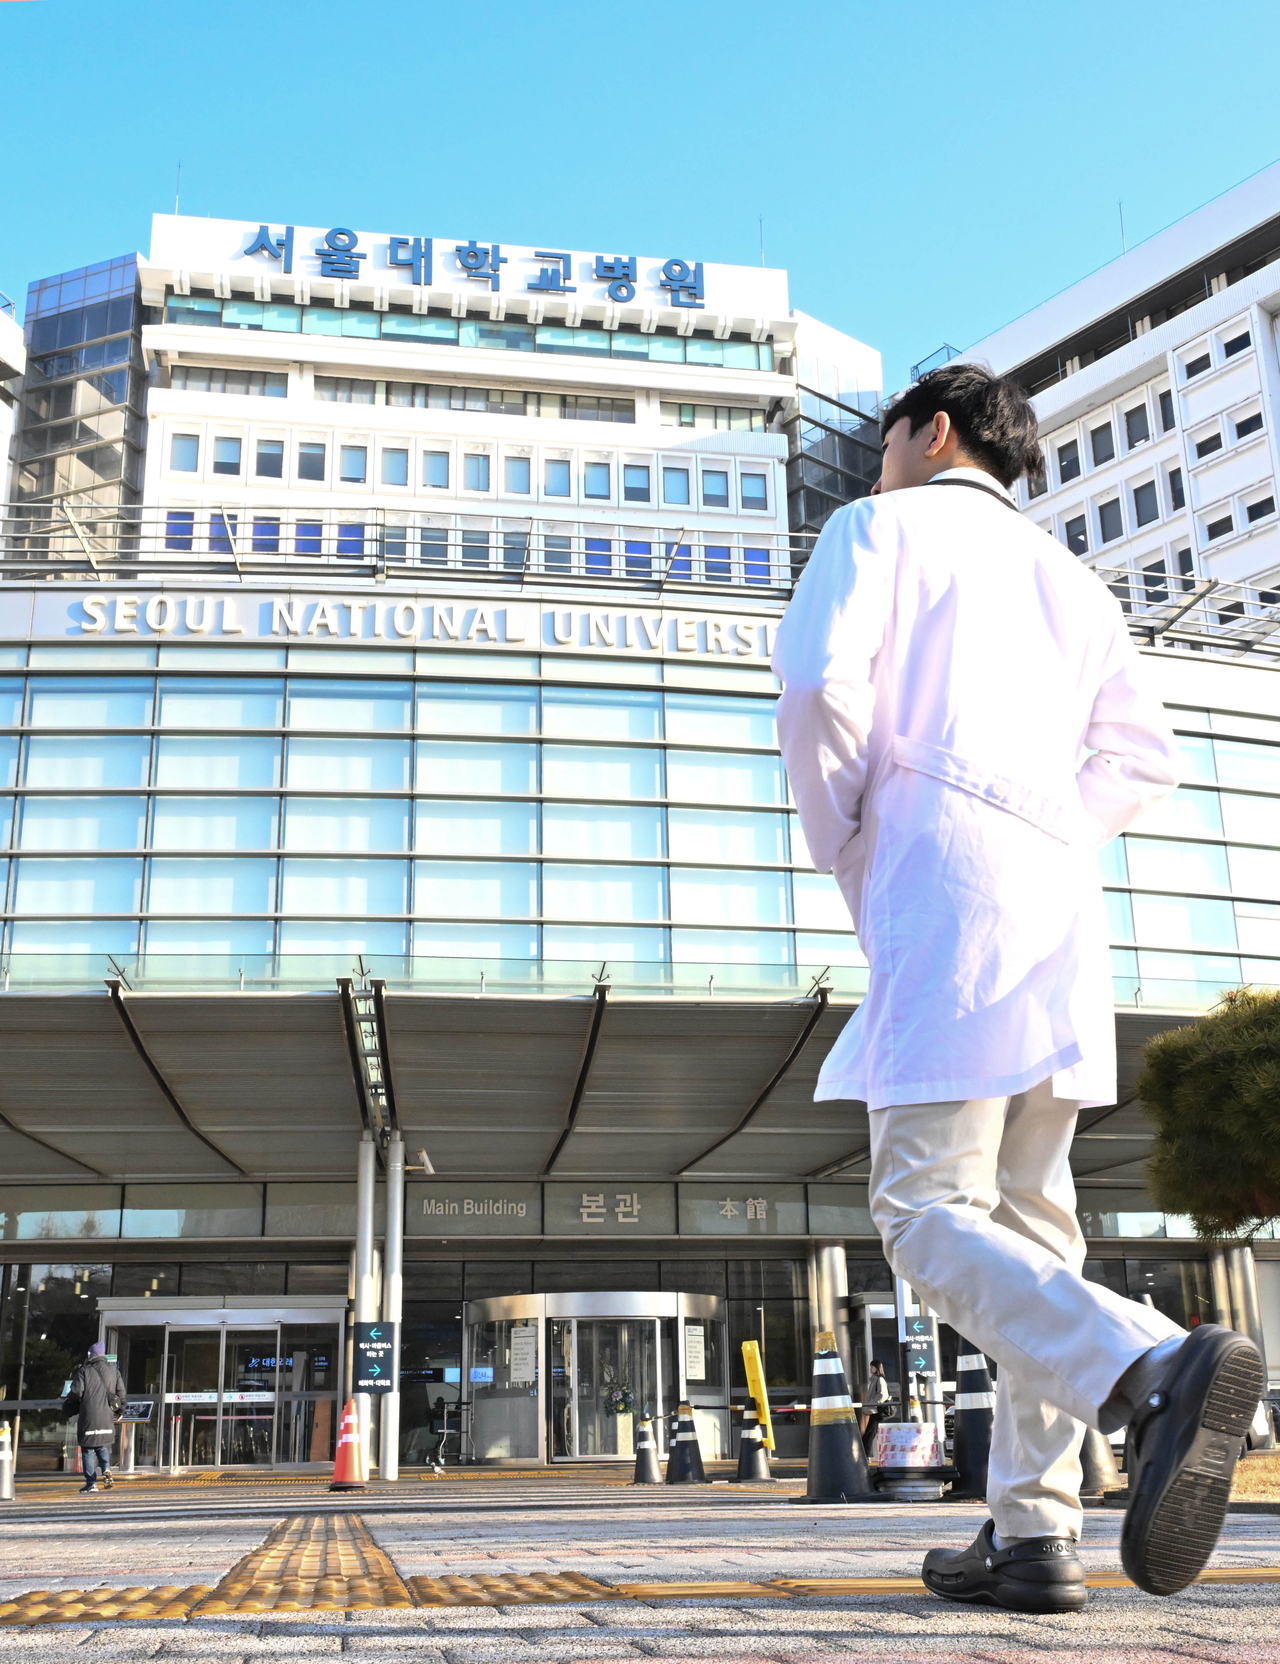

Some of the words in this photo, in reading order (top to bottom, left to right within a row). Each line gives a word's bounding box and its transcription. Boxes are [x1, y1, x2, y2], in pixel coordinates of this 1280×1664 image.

[244, 225, 706, 309] 서울대학교병원
[80, 594, 243, 634] SEOUL
[271, 597, 526, 643] NATIONAL
[423, 1199, 459, 1215] Main
[463, 1199, 527, 1217] Building
